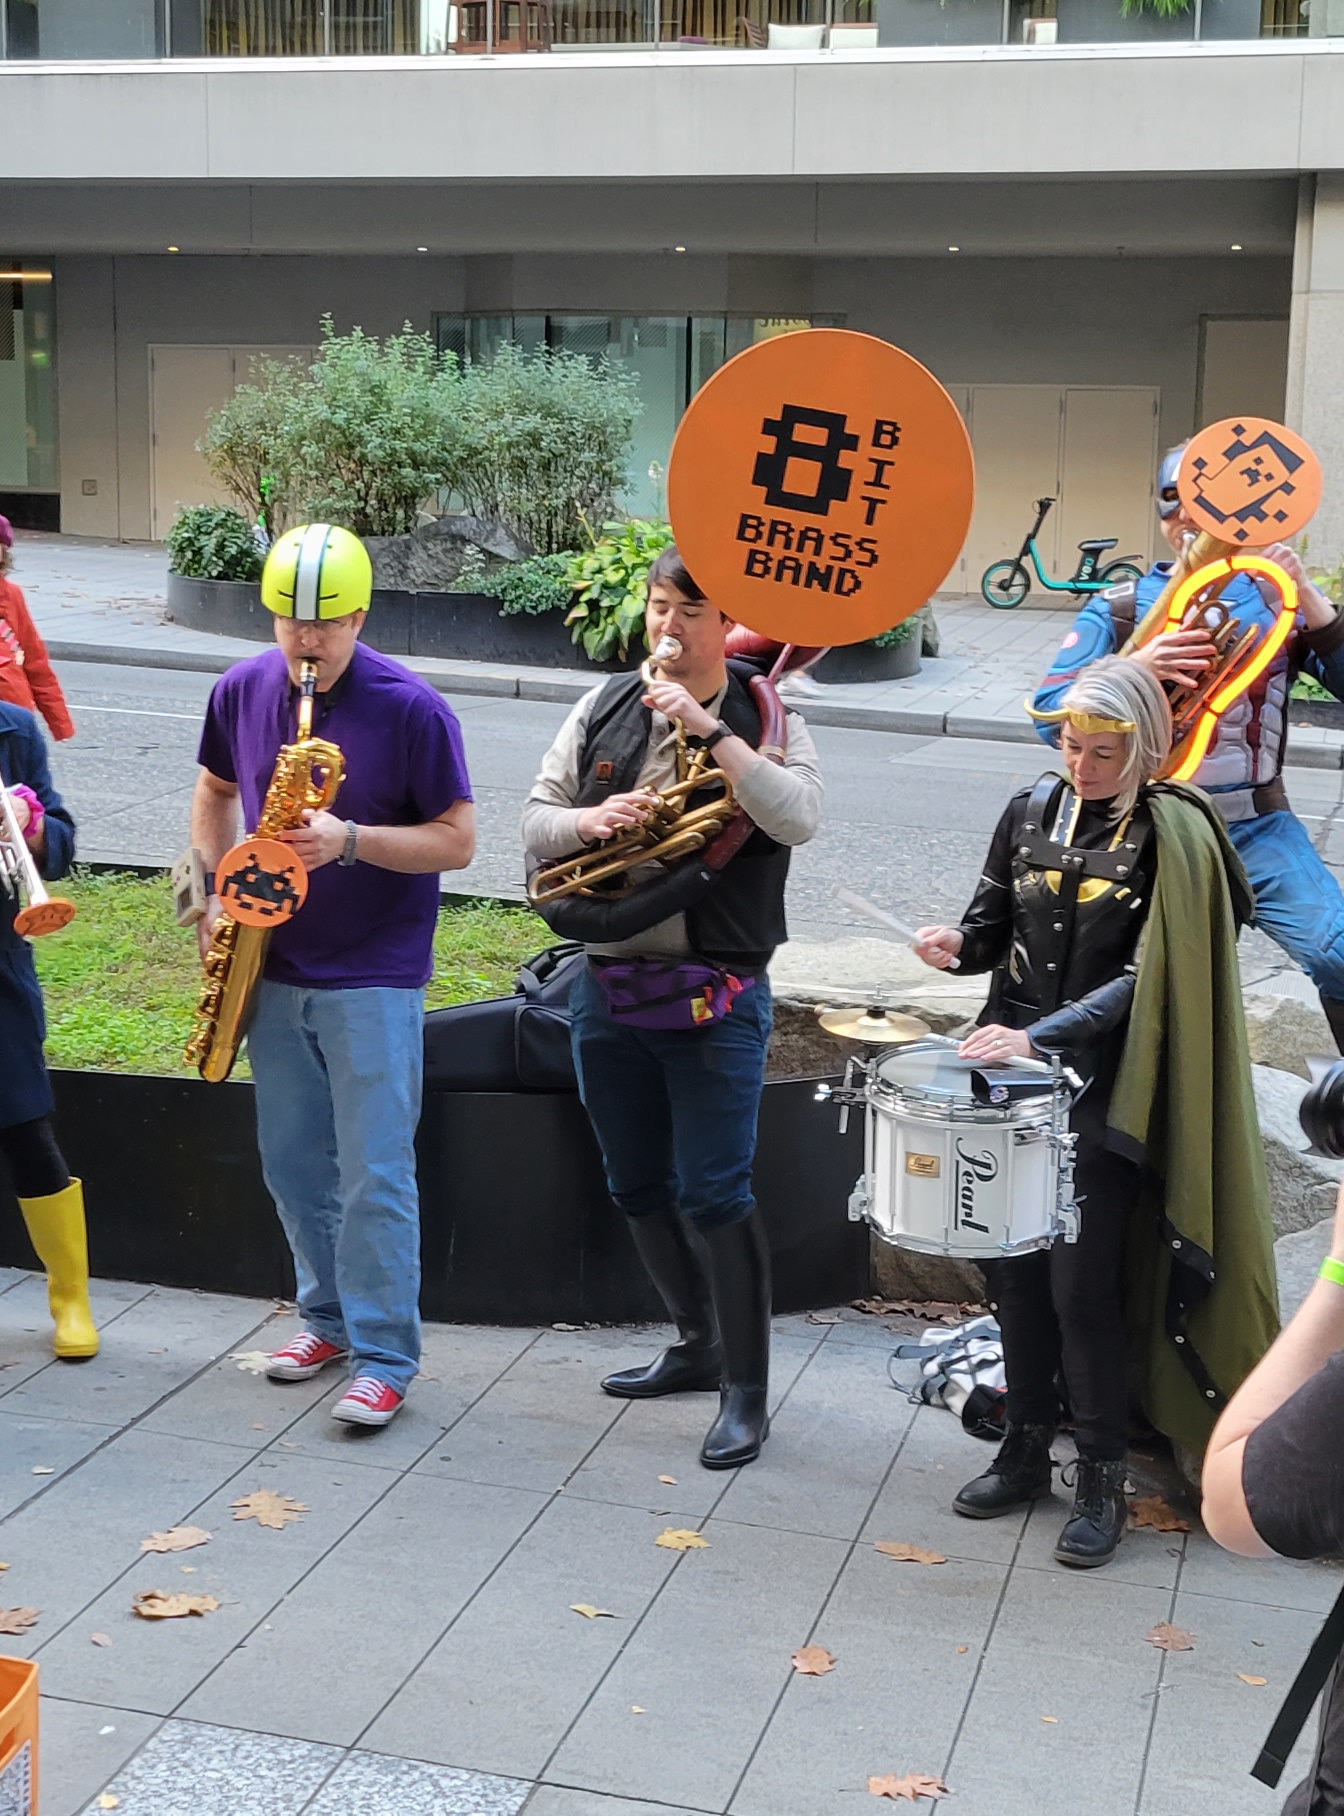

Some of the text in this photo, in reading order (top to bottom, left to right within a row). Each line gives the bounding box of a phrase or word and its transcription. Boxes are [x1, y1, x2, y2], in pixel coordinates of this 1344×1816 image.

[752, 404, 902, 525] 8 BIT
[735, 513, 879, 568] BRASS
[744, 549, 862, 597] BAND
[955, 1136, 999, 1234] Pearl
